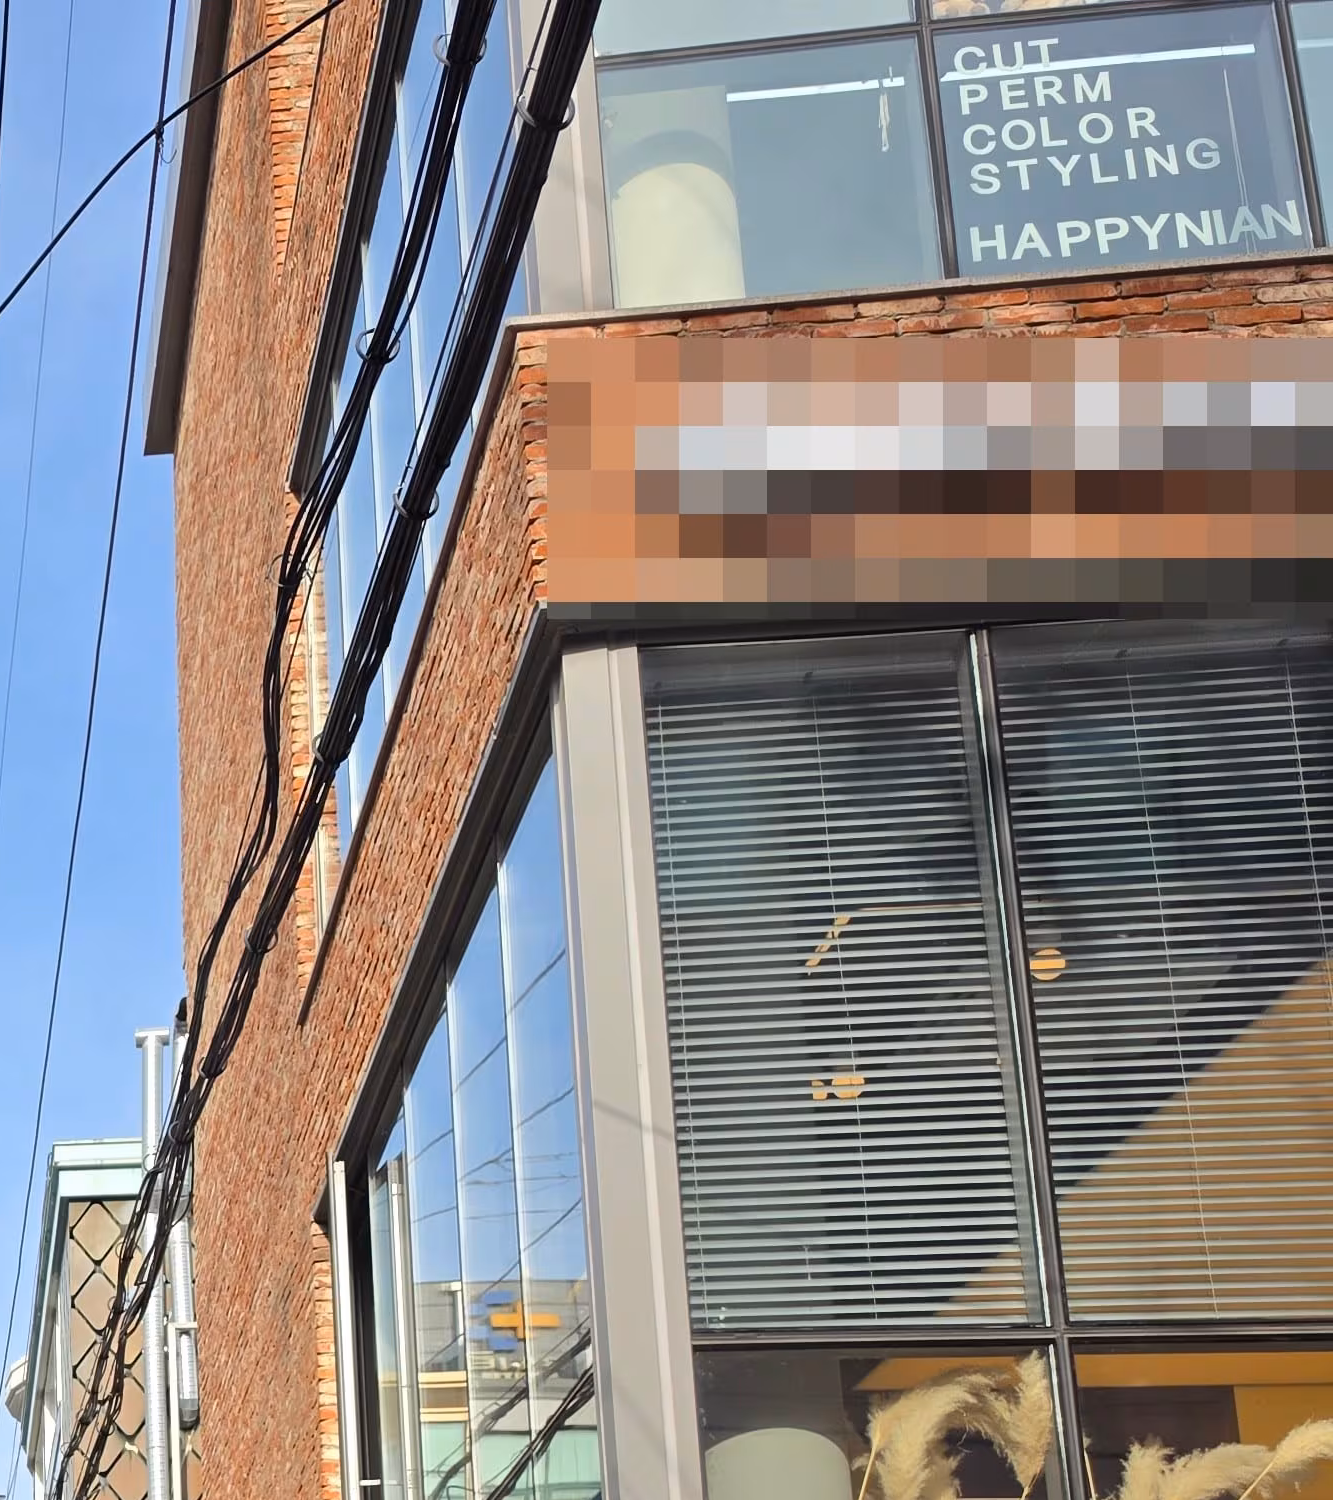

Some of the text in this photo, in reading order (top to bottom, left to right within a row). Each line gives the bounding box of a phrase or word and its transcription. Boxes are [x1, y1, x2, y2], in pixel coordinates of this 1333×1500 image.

[954, 38, 1060, 76] CUT
[959, 71, 1112, 115] PERM
[963, 107, 1160, 155] COLOR
[970, 138, 1221, 194] STYLING
[970, 200, 1303, 263] HAPPYNIAN
